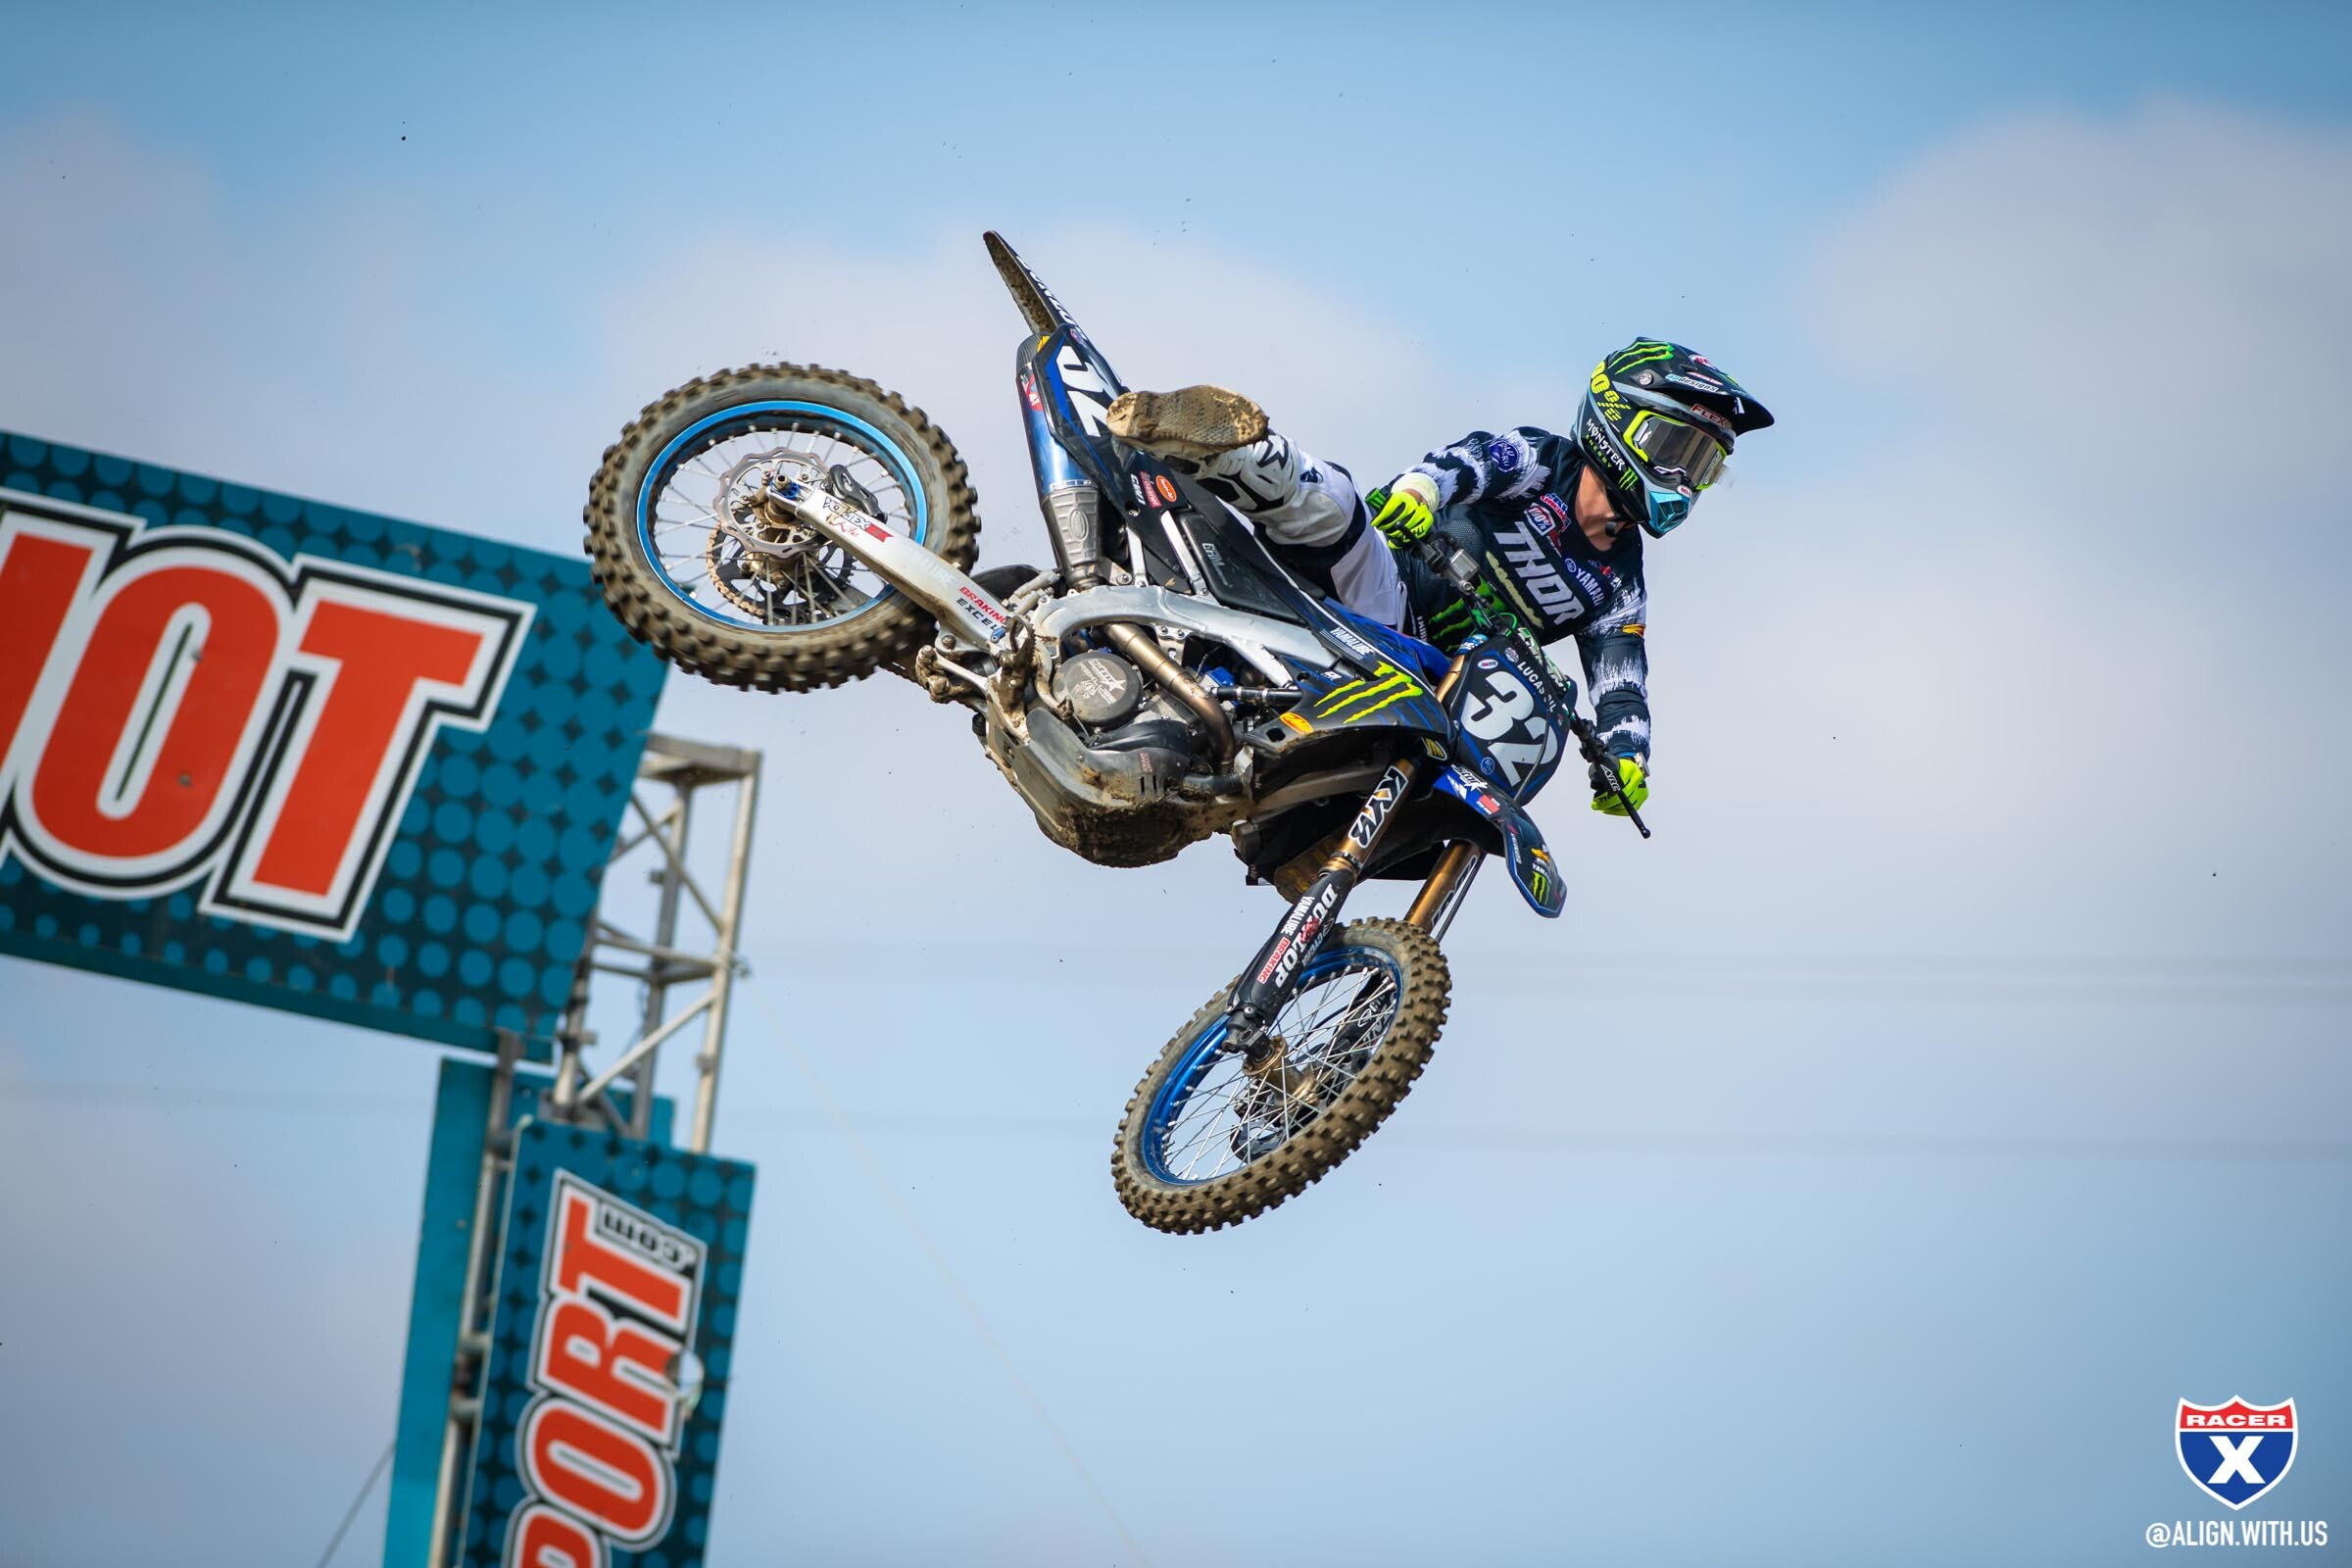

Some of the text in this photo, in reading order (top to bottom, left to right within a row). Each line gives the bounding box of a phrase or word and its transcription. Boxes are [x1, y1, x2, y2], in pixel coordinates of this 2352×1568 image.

[1585, 434, 1613, 468] ENERGY
[1586, 418, 1626, 470] MONSTER
[1528, 508, 1551, 530] 100%
[1493, 520, 1585, 625] THOR
[1575, 567, 1605, 607] YAMAH
[956, 598, 1004, 631] EXCEL
[1330, 627, 1375, 656] YAMALUBE
[1517, 662, 1545, 695] LUCAS
[0, 517, 510, 921] OT
[1460, 670, 1558, 787] 32
[1599, 764, 1621, 791] ARC
[1348, 765, 1408, 849] KYB
[1280, 896, 1315, 936] YAMALUBE
[1258, 938, 1290, 983] BRAKING
